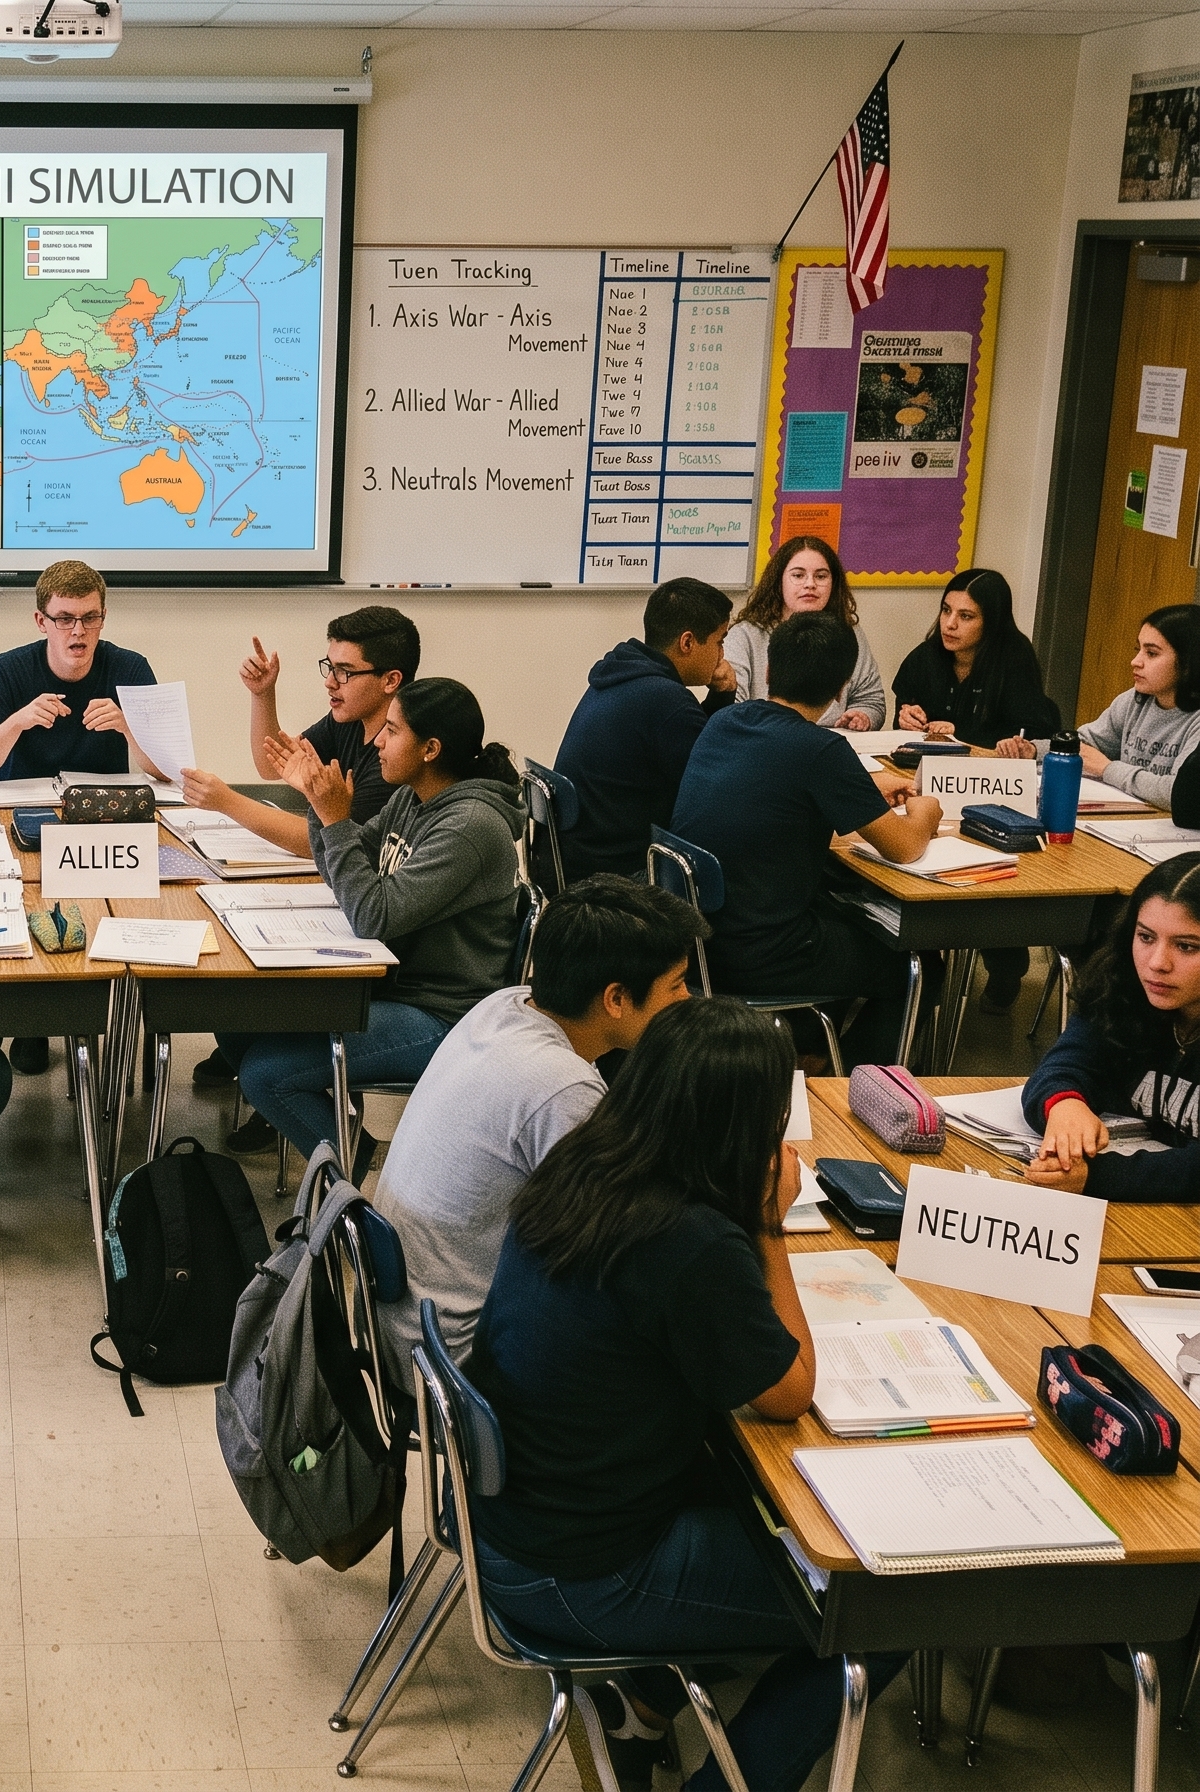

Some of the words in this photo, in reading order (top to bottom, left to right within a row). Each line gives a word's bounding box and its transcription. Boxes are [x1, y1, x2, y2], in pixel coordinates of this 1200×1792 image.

[29, 167, 294, 205] SIMULATION
[388, 259, 438, 280] Tuen
[451, 259, 532, 286] Tracking
[610, 258, 670, 273] Timeline
[642, 288, 646, 299] 1
[368, 305, 382, 328] 1.
[392, 302, 439, 328] Axis
[448, 304, 489, 328] War
[510, 303, 552, 327] Axis
[640, 306, 648, 316] 2
[638, 322, 646, 334] 3
[508, 334, 588, 353] Movement
[603, 374, 626, 384] Twe
[634, 374, 642, 384] 4
[364, 388, 384, 412] 2.
[392, 388, 446, 412] Allied
[453, 389, 492, 412] War
[509, 388, 559, 412] Allied
[602, 390, 626, 400] Twe
[633, 390, 640, 400] 4
[601, 406, 624, 417] Twe
[508, 418, 586, 437] Movement
[600, 424, 624, 435] Fave
[630, 424, 642, 435] 10
[146, 476, 182, 484] AUSTRALIA
[362, 466, 382, 491] 3.
[391, 466, 477, 491] Neutrals
[486, 467, 574, 491] Movement
[931, 776, 1023, 796] NEUTRALS
[58, 844, 140, 870] ALLIES
[918, 1204, 1080, 1264] NEUTRALS
